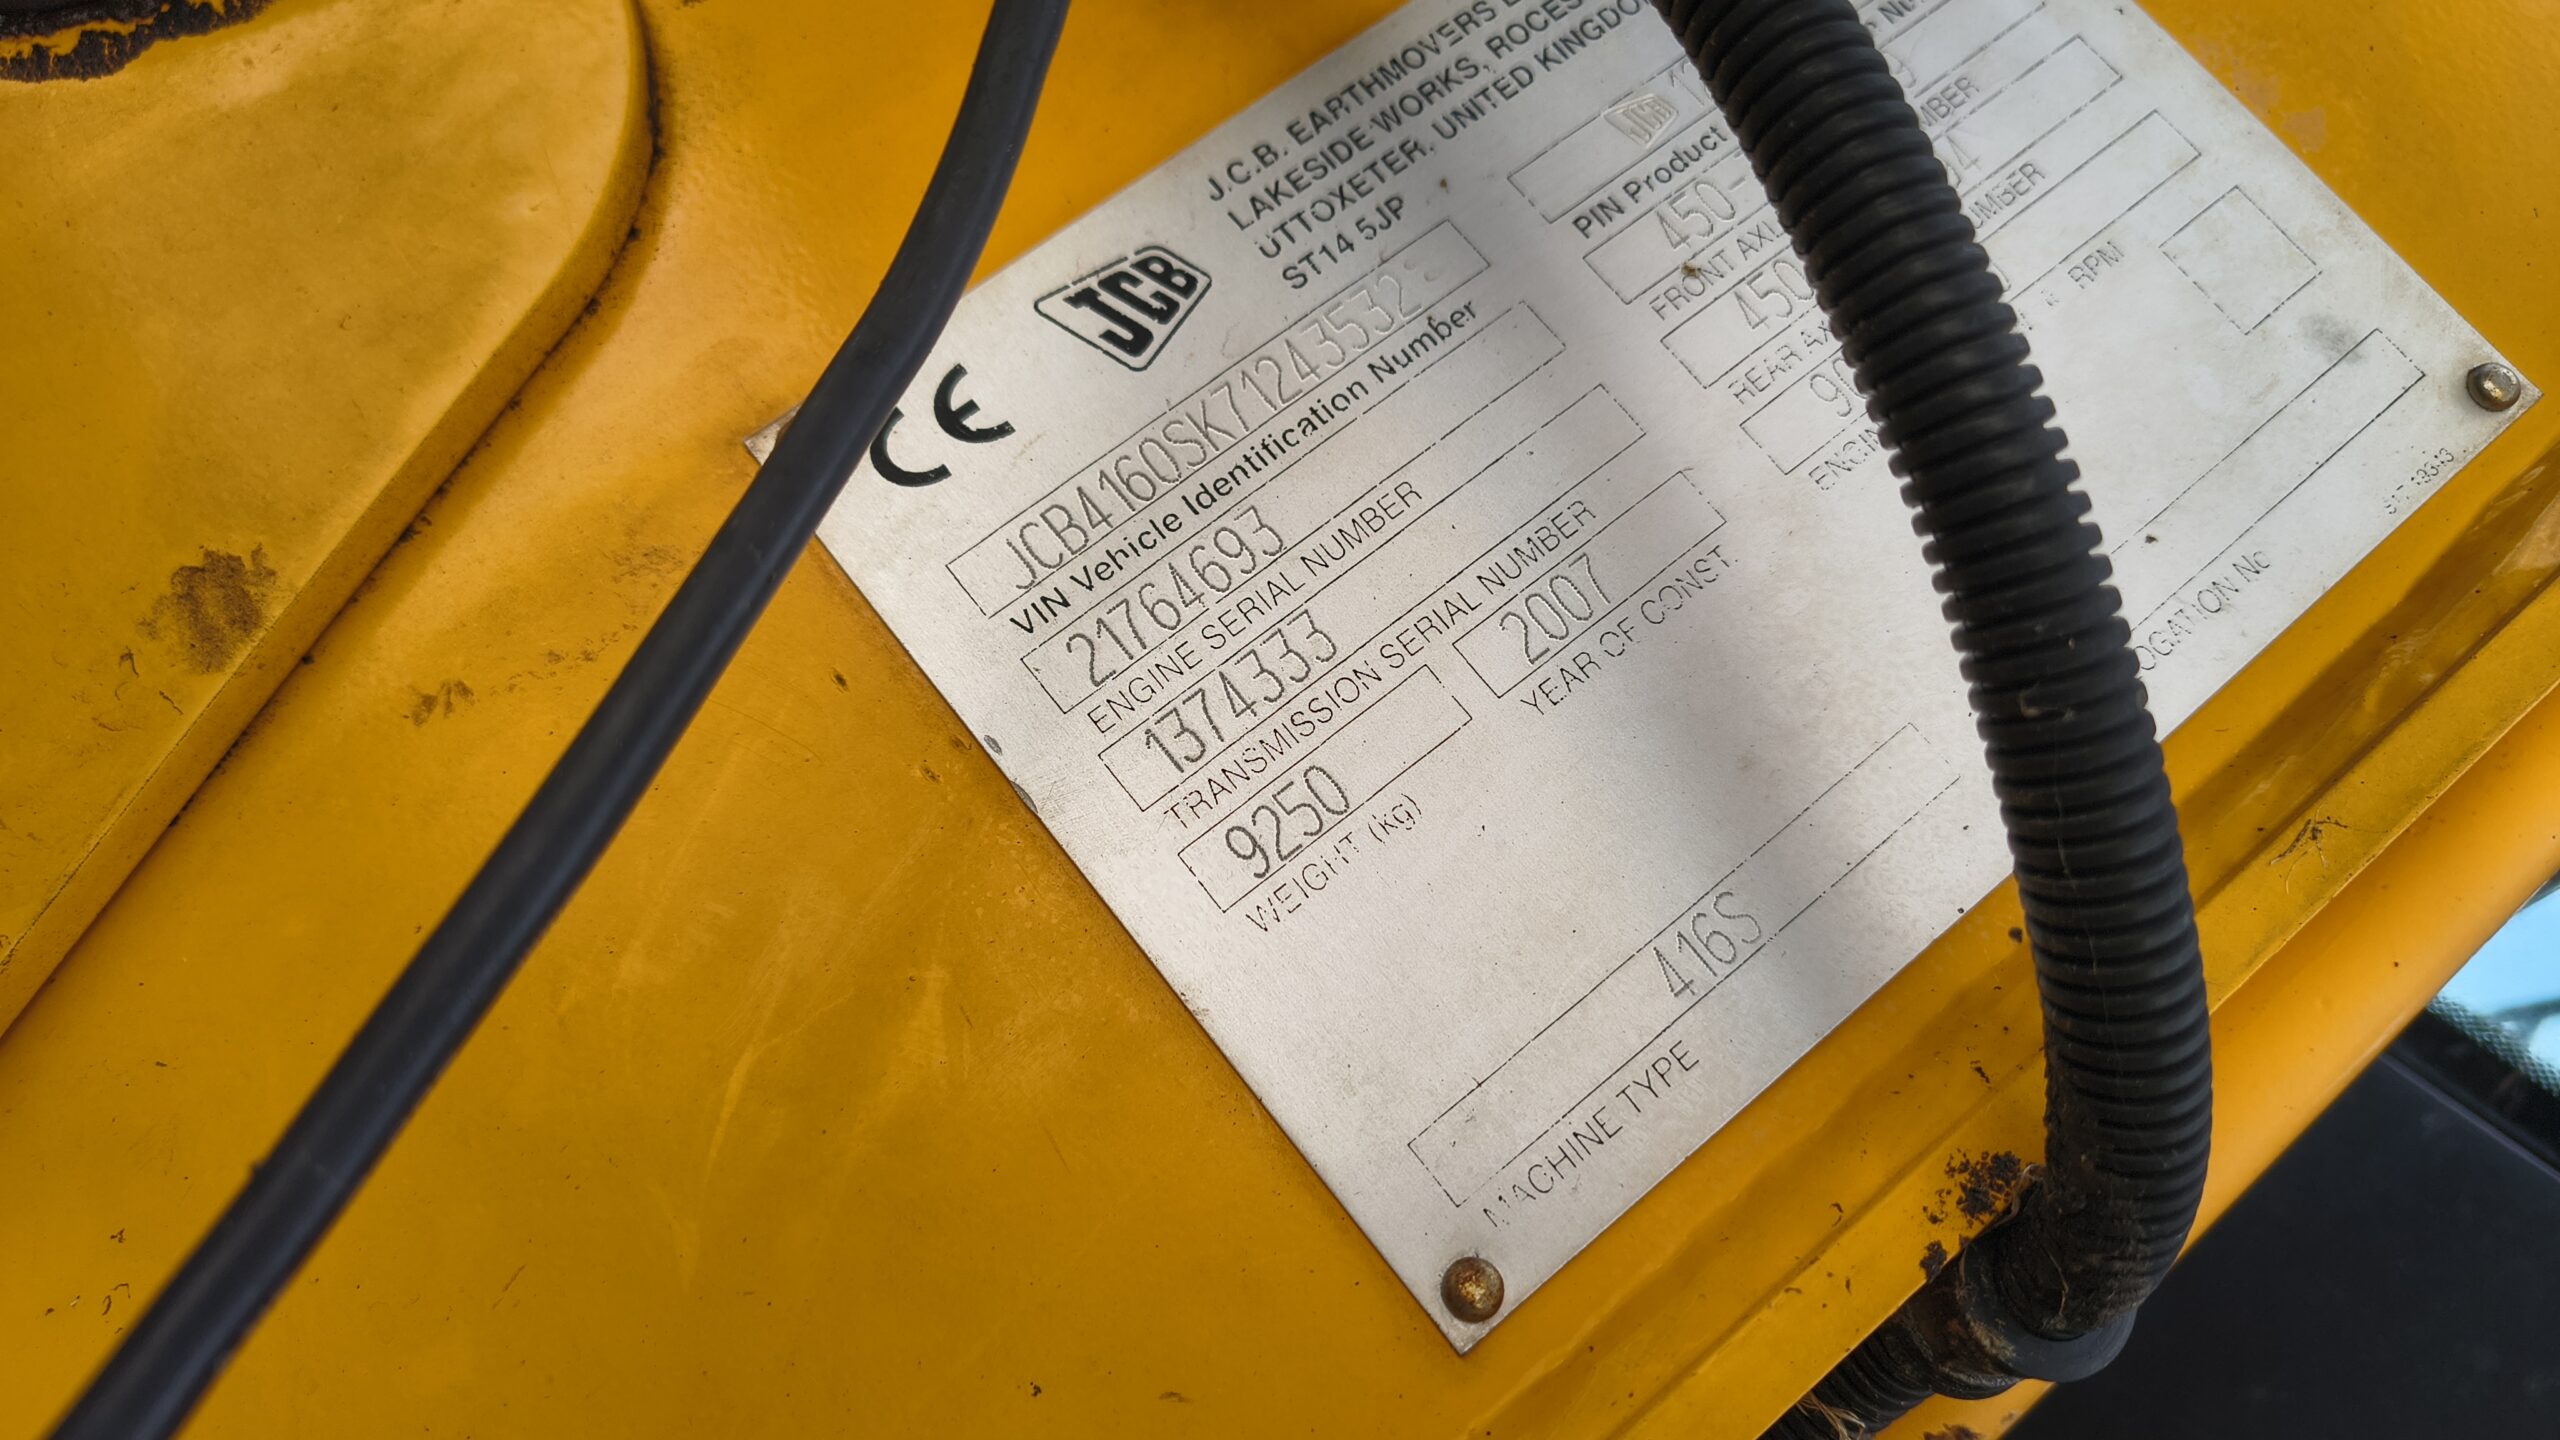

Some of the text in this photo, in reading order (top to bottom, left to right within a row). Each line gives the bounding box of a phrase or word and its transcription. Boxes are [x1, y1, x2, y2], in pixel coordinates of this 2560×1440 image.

[1207, 0, 1497, 202] J.C.B. EARTHMOVERS
[1432, 64, 1535, 140] UNITED
[1534, 0, 1652, 72] KINGDO
[1227, 127, 1374, 230] LAKESIDE
[1370, 56, 1490, 133] WORKS,
[1571, 124, 1728, 240] PIN Product
[1649, 76, 1980, 321] FRONT AXL MBER
[1065, 254, 1196, 358] JCB
[1281, 195, 1404, 290] ST14 5JP
[1727, 344, 1803, 405] REAR
[1968, 162, 2046, 230] UMBER
[2067, 240, 2124, 290] RPM
[870, 364, 1015, 487] CE
[1009, 301, 1476, 639] VIN Vehicle Identification Number
[1067, 507, 1285, 686] 21764693
[1087, 481, 1422, 734] ENGINE SERIAL NUMBER
[1164, 500, 1596, 827] TRANSMISSION SERIAL NUMBER
[1499, 554, 1610, 666] 2007
[1520, 544, 1738, 715] YEAR OF CONST.
[2134, 576, 2240, 671] OGATION
[1144, 610, 1338, 772] 1374333
[1225, 765, 1351, 879] 9250
[1245, 793, 1423, 932] WEIGHT (kg)
[1653, 890, 1762, 999] 416S
[1615, 1040, 1700, 1114] TYPE
